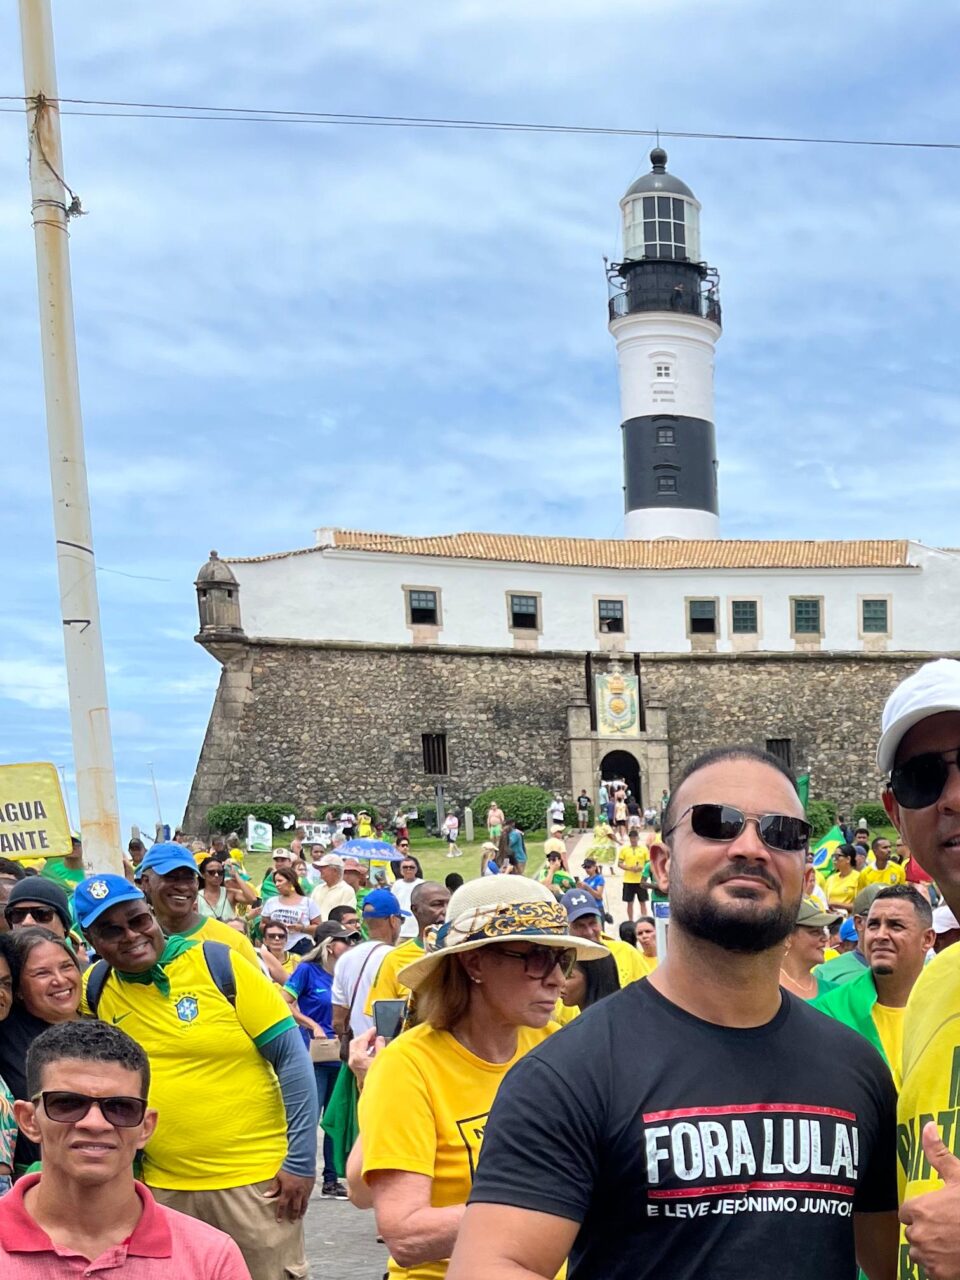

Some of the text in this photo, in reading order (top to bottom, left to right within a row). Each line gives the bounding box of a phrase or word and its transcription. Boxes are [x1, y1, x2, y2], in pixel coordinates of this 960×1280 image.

[644, 1118, 859, 1184] FORA LULA!
[647, 1204, 659, 1217] E
[664, 1201, 711, 1219] LEVE
[800, 1196, 853, 1217] JUNTO!
